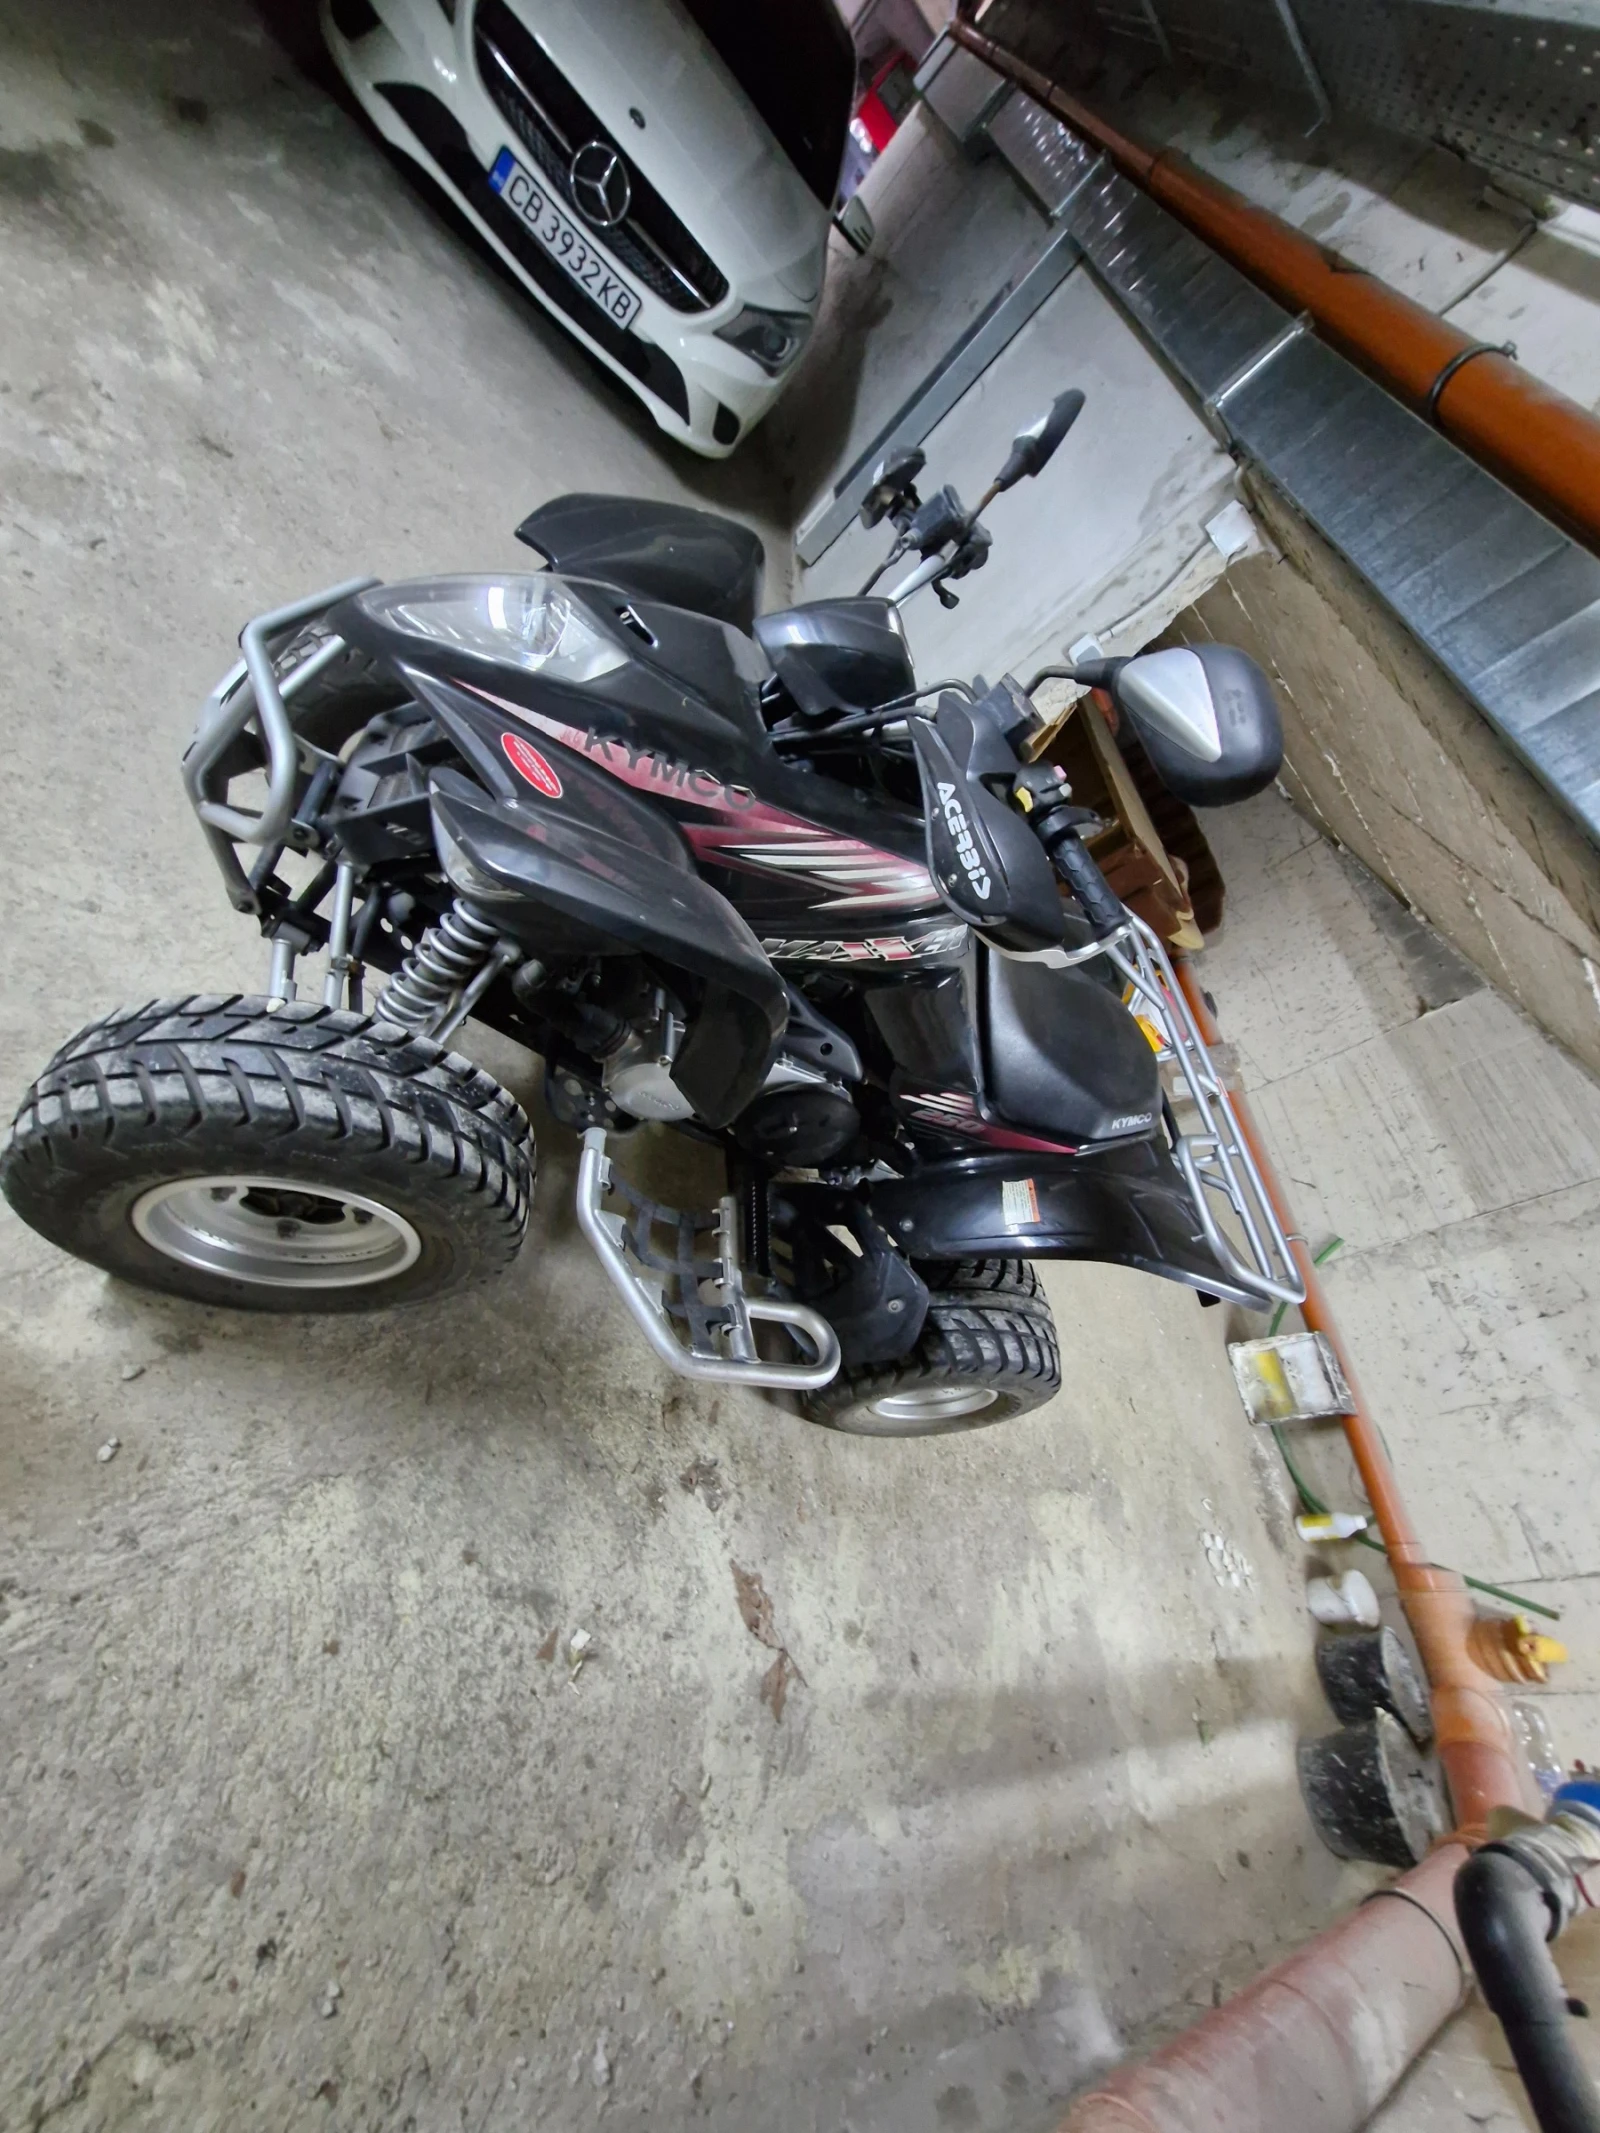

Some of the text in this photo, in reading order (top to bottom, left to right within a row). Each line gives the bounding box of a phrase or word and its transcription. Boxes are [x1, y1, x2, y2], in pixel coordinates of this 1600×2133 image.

[508, 175, 543, 223] CB
[542, 214, 601, 289] 3932
[584, 726, 756, 811] KYMCO
[910, 1109, 985, 1133] 250
[1111, 1111, 1153, 1131] KYMCO
